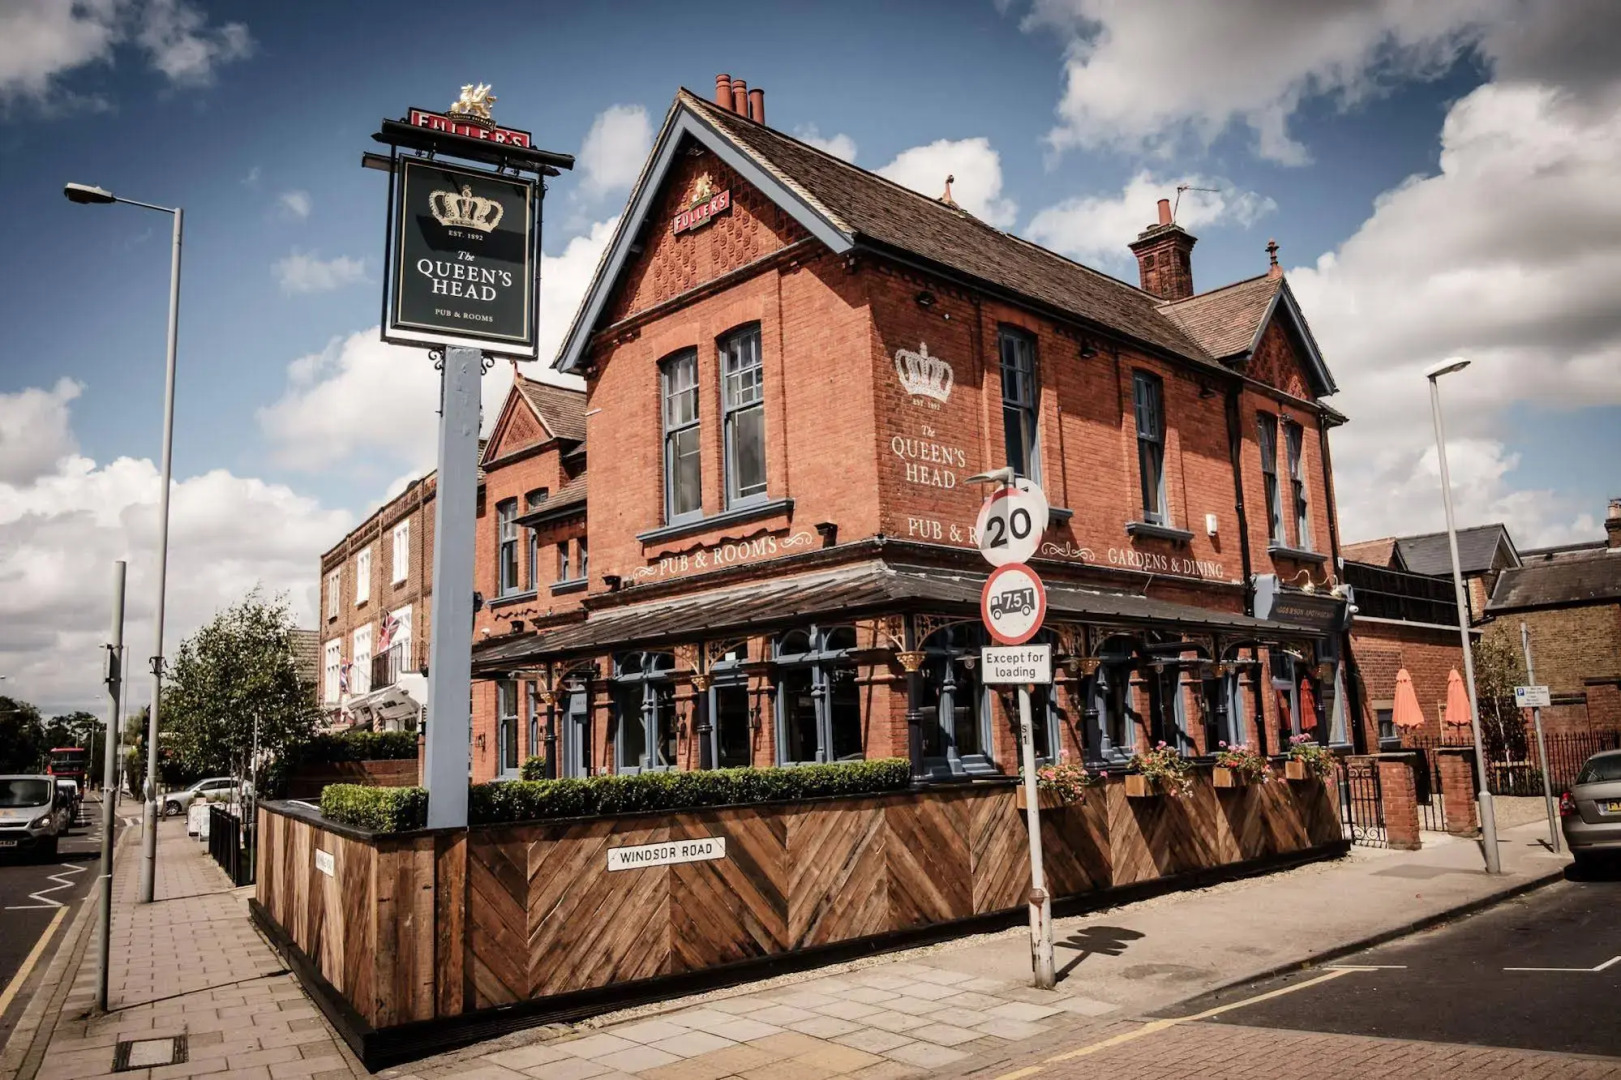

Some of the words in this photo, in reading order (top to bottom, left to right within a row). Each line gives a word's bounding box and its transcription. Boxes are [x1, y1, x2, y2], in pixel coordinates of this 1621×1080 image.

[676, 195, 725, 230] FULLER'S
[448, 230, 465, 238] EST.
[467, 233, 484, 241] 1892
[457, 250, 475, 262] The
[417, 258, 512, 287] QUEEN'S
[432, 278, 497, 301] HEAD
[435, 308, 452, 317] PUB
[463, 312, 494, 322] ROOMS
[921, 424, 936, 437] The
[891, 435, 966, 468] QUEEN'S
[905, 461, 956, 489] HEAD
[907, 517, 943, 540] PUB
[949, 524, 963, 543] &
[987, 507, 1031, 549] 20
[660, 554, 689, 576] PUB
[694, 549, 708, 568] &
[713, 535, 777, 565] ROOMS
[1107, 547, 1168, 571] GARDENS
[1170, 557, 1180, 572] &
[1183, 558, 1224, 578] DINING
[986, 652, 1024, 665] Except
[1027, 651, 1044, 662] for
[995, 666, 1036, 679] loading
[1021, 725, 1027, 733] S
[1023, 735, 1027, 745] 1
[620, 847, 676, 864] WINDSOR
[682, 843, 713, 857] ROAD
